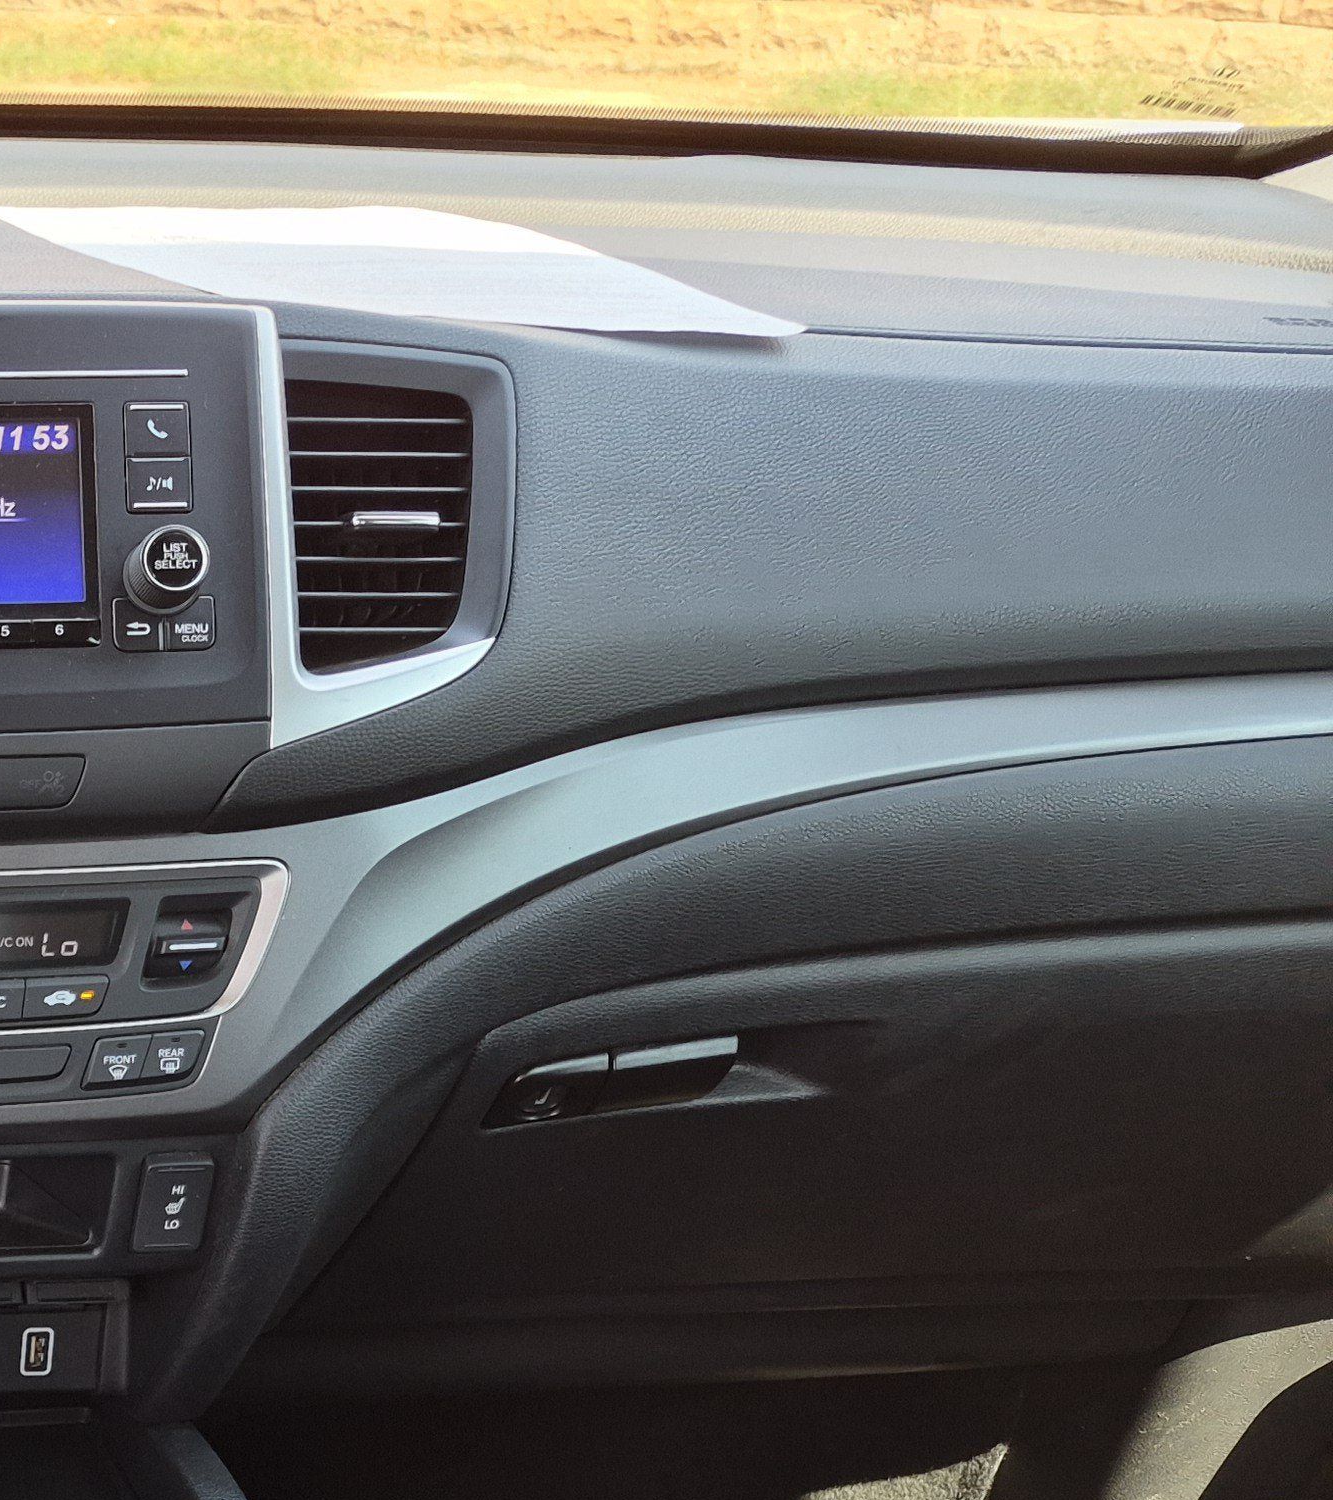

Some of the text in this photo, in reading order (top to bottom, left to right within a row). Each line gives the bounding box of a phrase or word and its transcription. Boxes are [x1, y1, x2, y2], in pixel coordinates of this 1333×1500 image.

[163, 542, 188, 553] LIST
[164, 552, 189, 560] PUSH
[154, 560, 198, 570] SELECT
[0, 625, 10, 638] 5
[55, 623, 64, 637] 6
[175, 623, 209, 634] MENU
[181, 634, 209, 642] CLOCK
[15, 936, 34, 948] ON
[158, 1048, 185, 1058] REAR
[103, 1055, 137, 1065] FRONT
[171, 1185, 186, 1195] HI
[164, 1219, 180, 1230] LO
